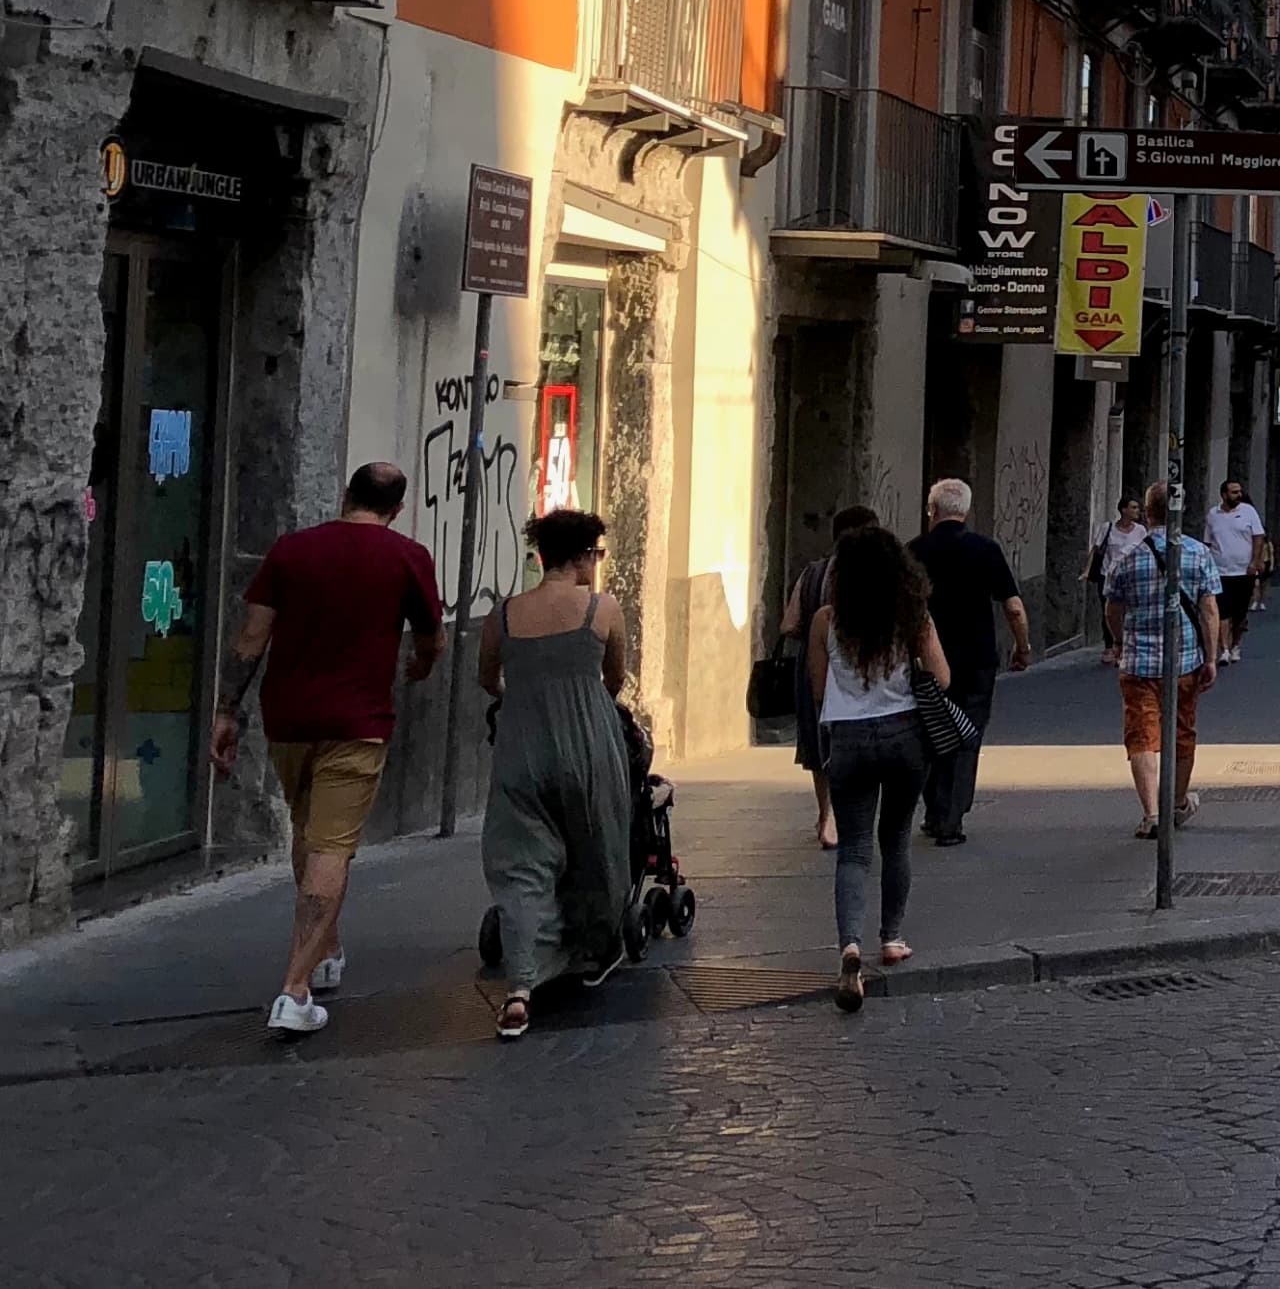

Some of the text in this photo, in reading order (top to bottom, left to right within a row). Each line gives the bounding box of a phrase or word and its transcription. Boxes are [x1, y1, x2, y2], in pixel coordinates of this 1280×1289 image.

[1136, 134, 1195, 148] Basilica
[1136, 150, 1215, 166] S.Giovanni
[987, 251, 1025, 259] STORE
[1072, 191, 1138, 309] ALDI
[968, 265, 1049, 278] Abbigliamento
[1075, 311, 1123, 325] GAIA
